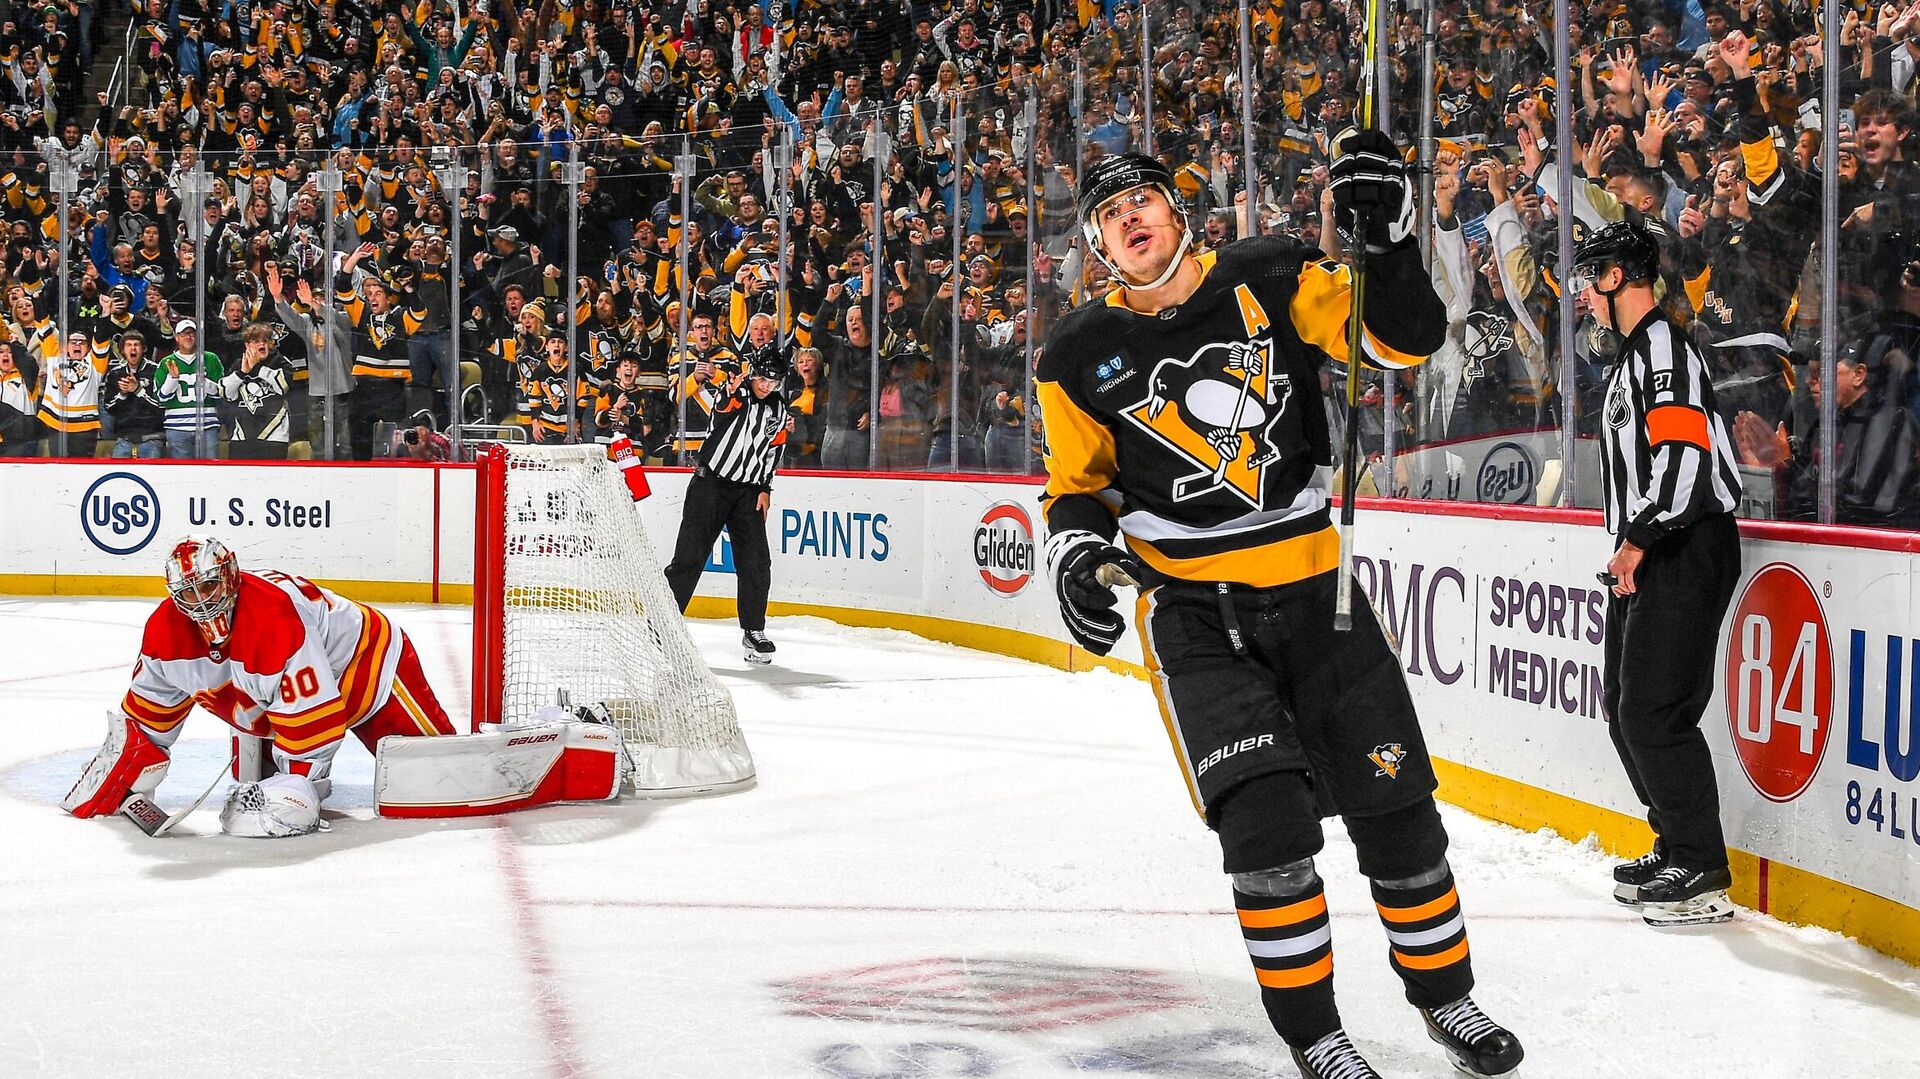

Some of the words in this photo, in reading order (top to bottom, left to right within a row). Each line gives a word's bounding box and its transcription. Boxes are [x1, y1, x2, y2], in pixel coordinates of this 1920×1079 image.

[1233, 283, 1271, 338] A
[1654, 372, 1672, 391] 27
[93, 495, 149, 535] USS
[189, 497, 216, 526] U.
[229, 497, 254, 526] S.
[265, 498, 331, 528] Steel
[781, 509, 890, 562] PAINTS
[974, 527, 1035, 572] Glidden
[1489, 575, 1605, 645] SPORTS
[279, 666, 319, 704] 80
[1737, 613, 1819, 755] 84
[1846, 628, 1920, 782] LU
[143, 763, 168, 775] MACH
